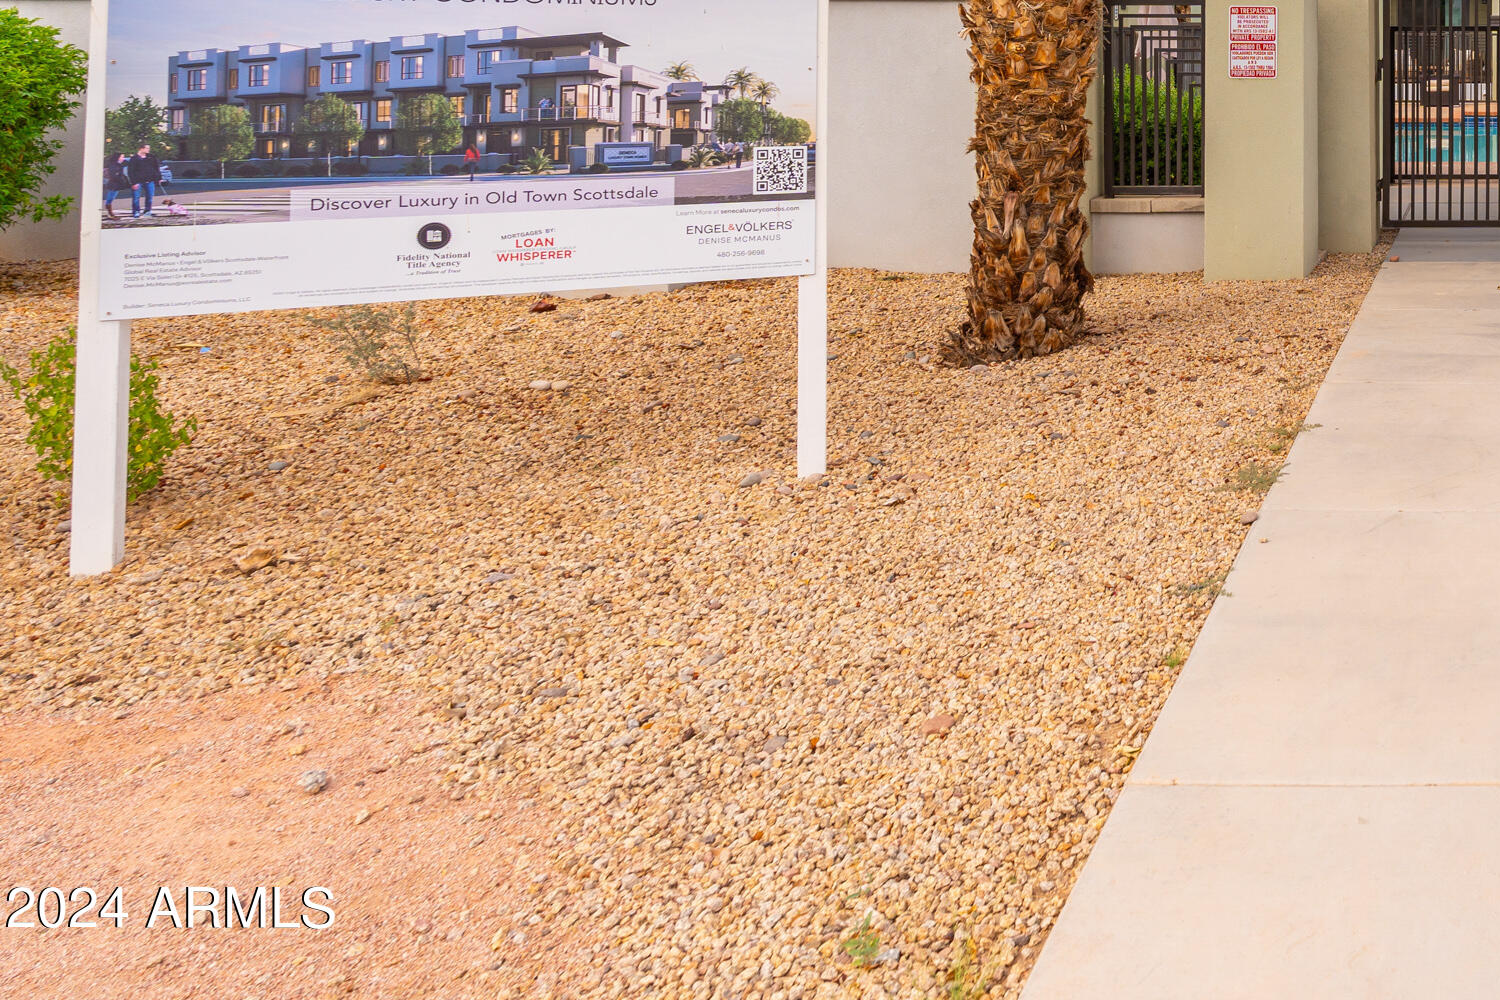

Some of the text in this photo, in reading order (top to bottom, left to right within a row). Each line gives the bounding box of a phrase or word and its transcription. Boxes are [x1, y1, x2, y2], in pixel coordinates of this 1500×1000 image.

[310, 186, 659, 211] Discover Luxury in Old Town Scottsdale
[720, 205, 800, 215] senecaluxurycondos.com
[686, 220, 793, 235] ENGEL&VÖLKERS
[500, 229, 543, 240] MORTGAGES
[698, 233, 782, 245] DENISE MCMANUS
[515, 237, 555, 249] LOAN
[396, 251, 471, 262] Fidelity National
[496, 250, 572, 262] WHISPERER
[406, 260, 461, 269] Title Agency
